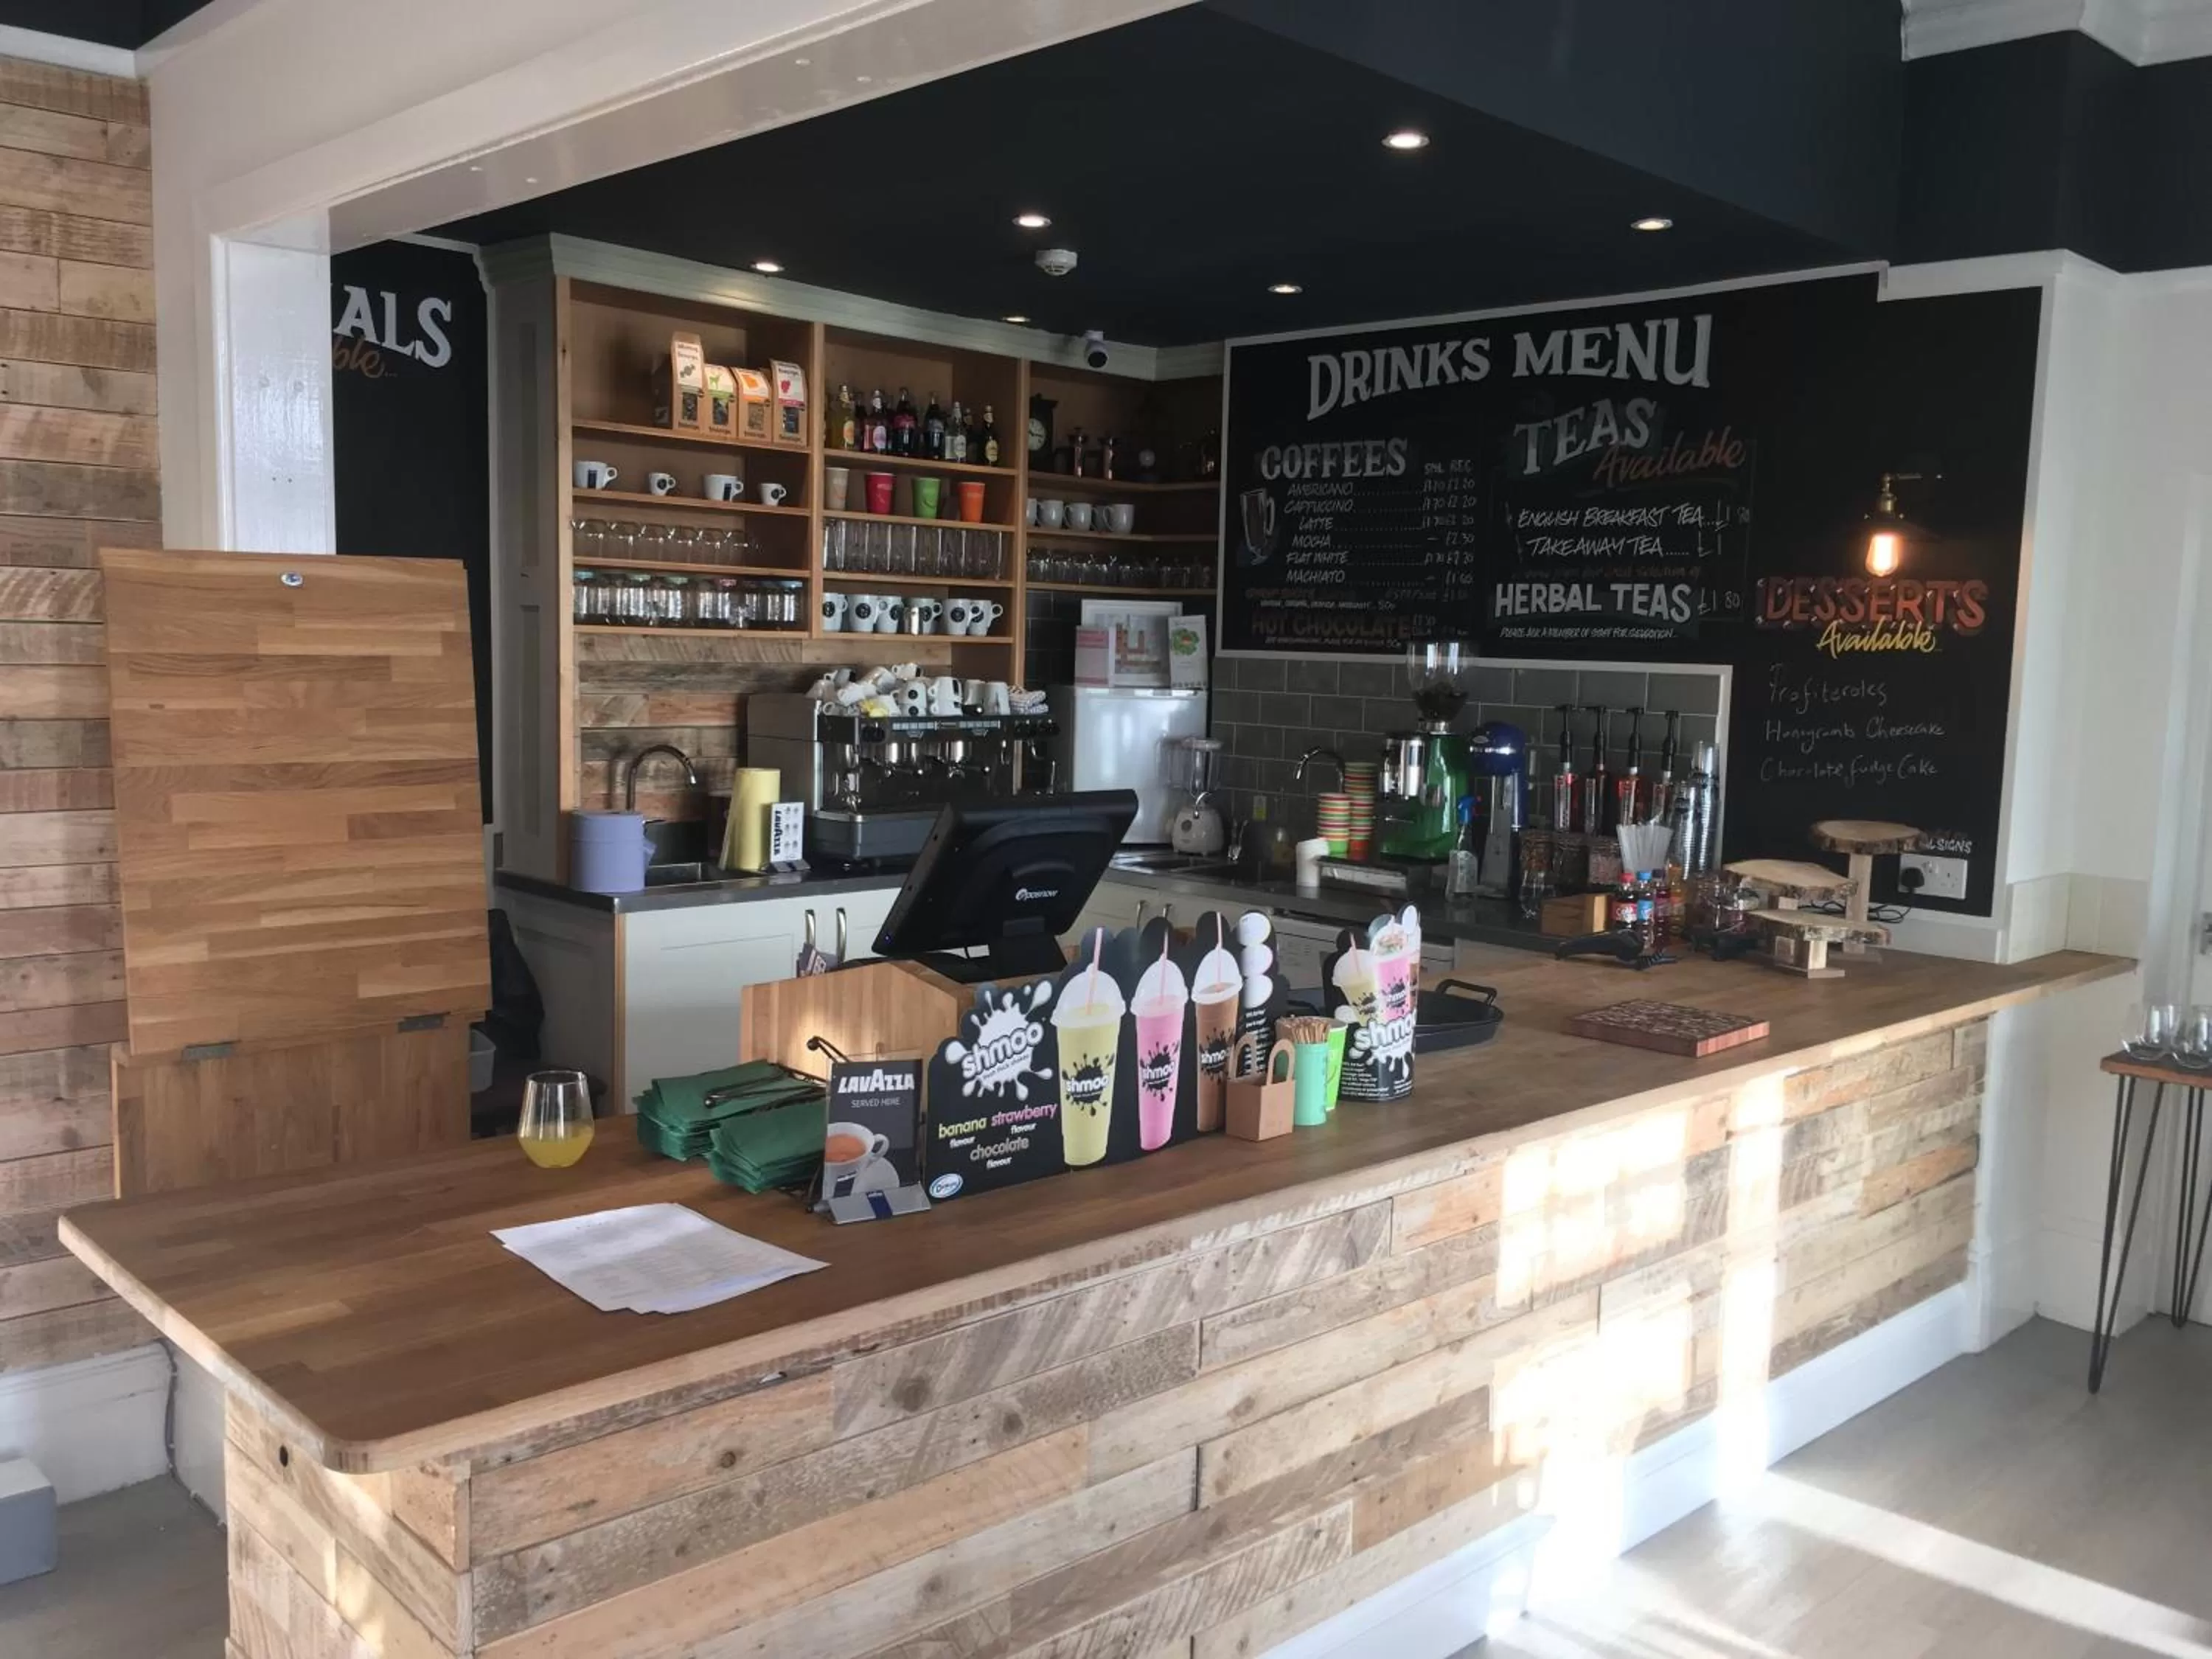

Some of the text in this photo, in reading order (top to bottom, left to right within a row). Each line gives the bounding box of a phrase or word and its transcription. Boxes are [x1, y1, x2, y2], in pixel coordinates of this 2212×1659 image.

[333, 284, 452, 369] ALS
[1307, 314, 1712, 422] DRINKS MENU
[1513, 397, 1657, 476] TEAS
[1261, 437, 1408, 480] COFFEES
[1593, 425, 1746, 487] Available
[1298, 516, 1334, 531] LATTE
[1517, 508, 1579, 528] ENGLISH
[1582, 504, 1672, 528] BREAKFAST
[1292, 534, 1331, 549] MOCHA
[1526, 536, 1625, 557] TAKEAWAY
[1286, 569, 1345, 584] MACHIATO
[1495, 582, 1602, 618] HERBAL
[1610, 582, 1691, 624] TEAS
[1758, 577, 1989, 636] DESSERTS
[1292, 613, 1411, 639] CHOCOLATE
[1815, 616, 1935, 659] Available
[961, 1020, 1044, 1079] shmoo
[838, 1068, 914, 1093] LAVAZZA
[851, 1097, 880, 1108] SERVED
[939, 1102, 1059, 1140] banana strawberry
[970, 1135, 1030, 1162] chocolate
